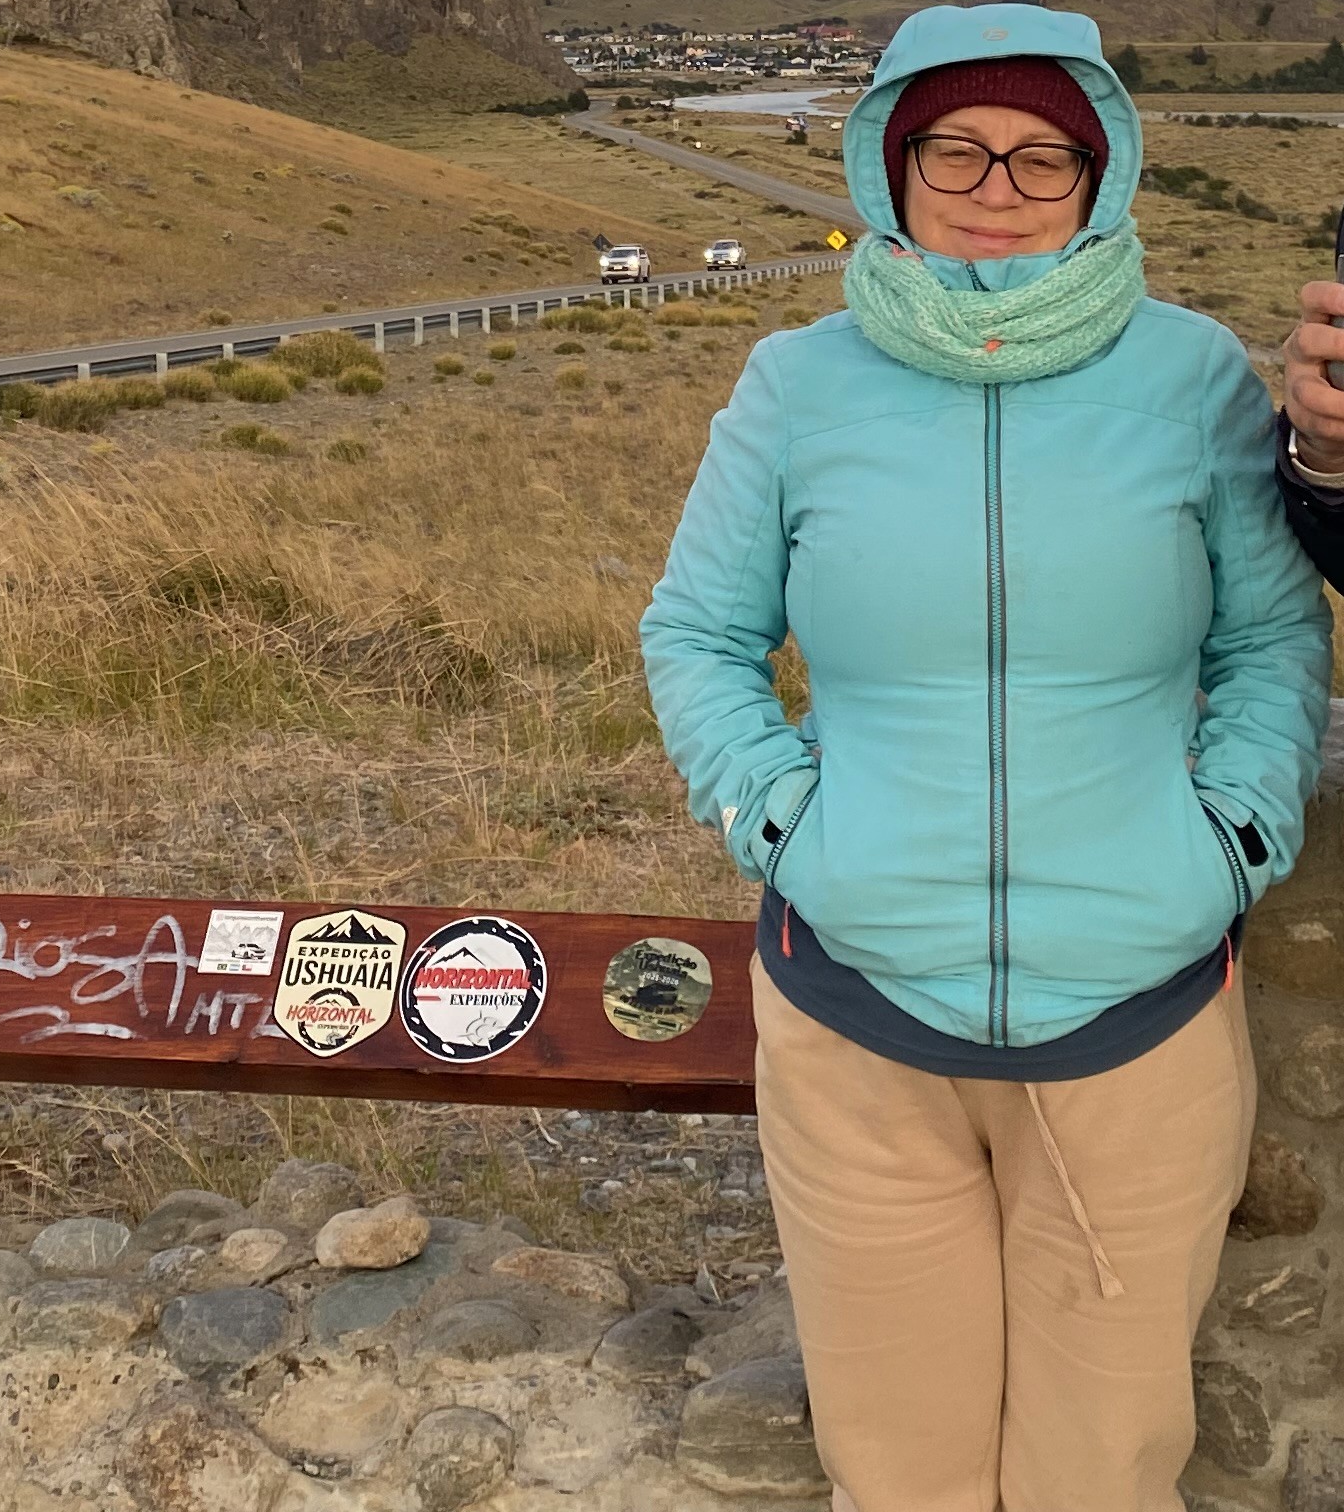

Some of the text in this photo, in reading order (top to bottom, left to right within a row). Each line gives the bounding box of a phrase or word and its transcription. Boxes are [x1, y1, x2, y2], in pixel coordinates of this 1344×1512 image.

[297, 947, 392, 961] EXPEDIÇÃO
[285, 957, 393, 990] USHUAIA
[416, 967, 532, 990] HORIZONTAL
[449, 992, 525, 1010] EXPEDIÇÕES
[286, 1004, 376, 1026] HORIZONTAL
